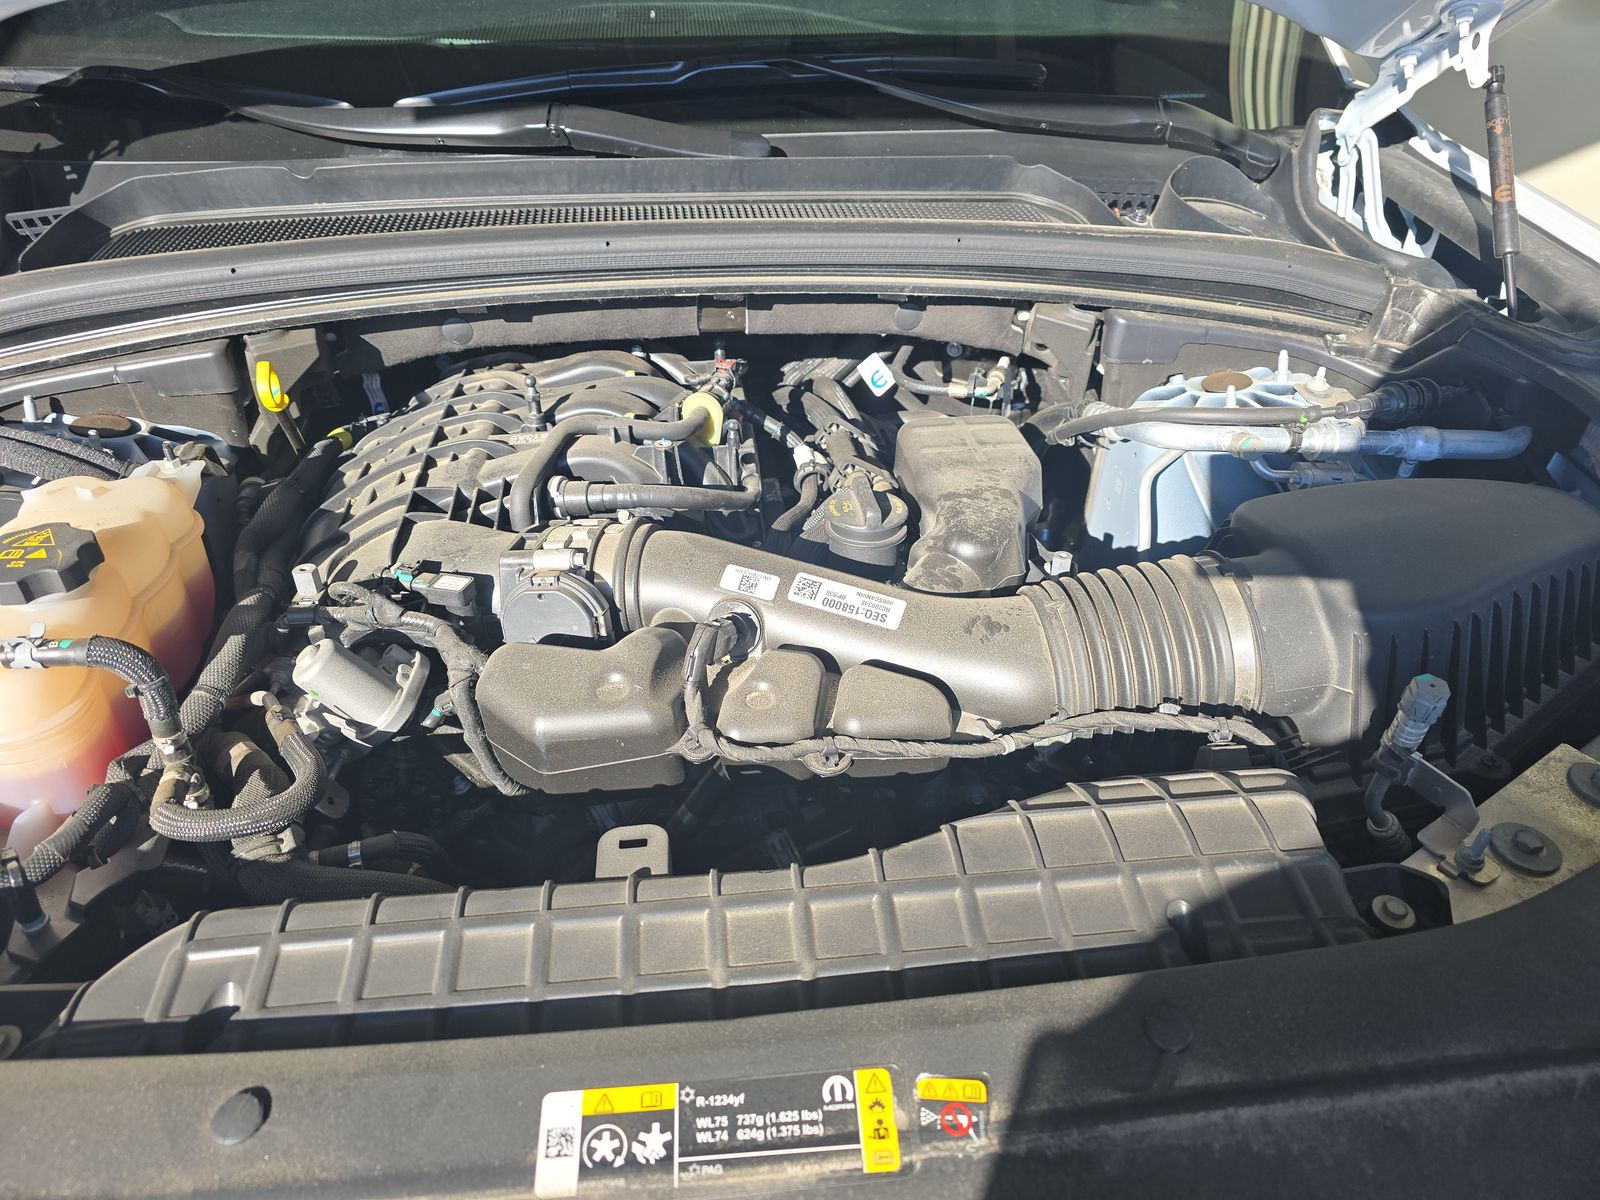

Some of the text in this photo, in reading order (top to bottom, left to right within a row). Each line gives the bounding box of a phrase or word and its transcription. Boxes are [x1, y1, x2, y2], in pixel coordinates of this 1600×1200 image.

[1486, 115, 1510, 128] BODY
[821, 597, 888, 623] SEQ:158000
[695, 1092, 746, 1108] R-1234yf
[695, 1108, 823, 1129] WL75 737g (1.625 lbs)
[695, 1123, 825, 1143] WL74 624g (1.375 lbs)
[701, 1163, 723, 1176] PAG
